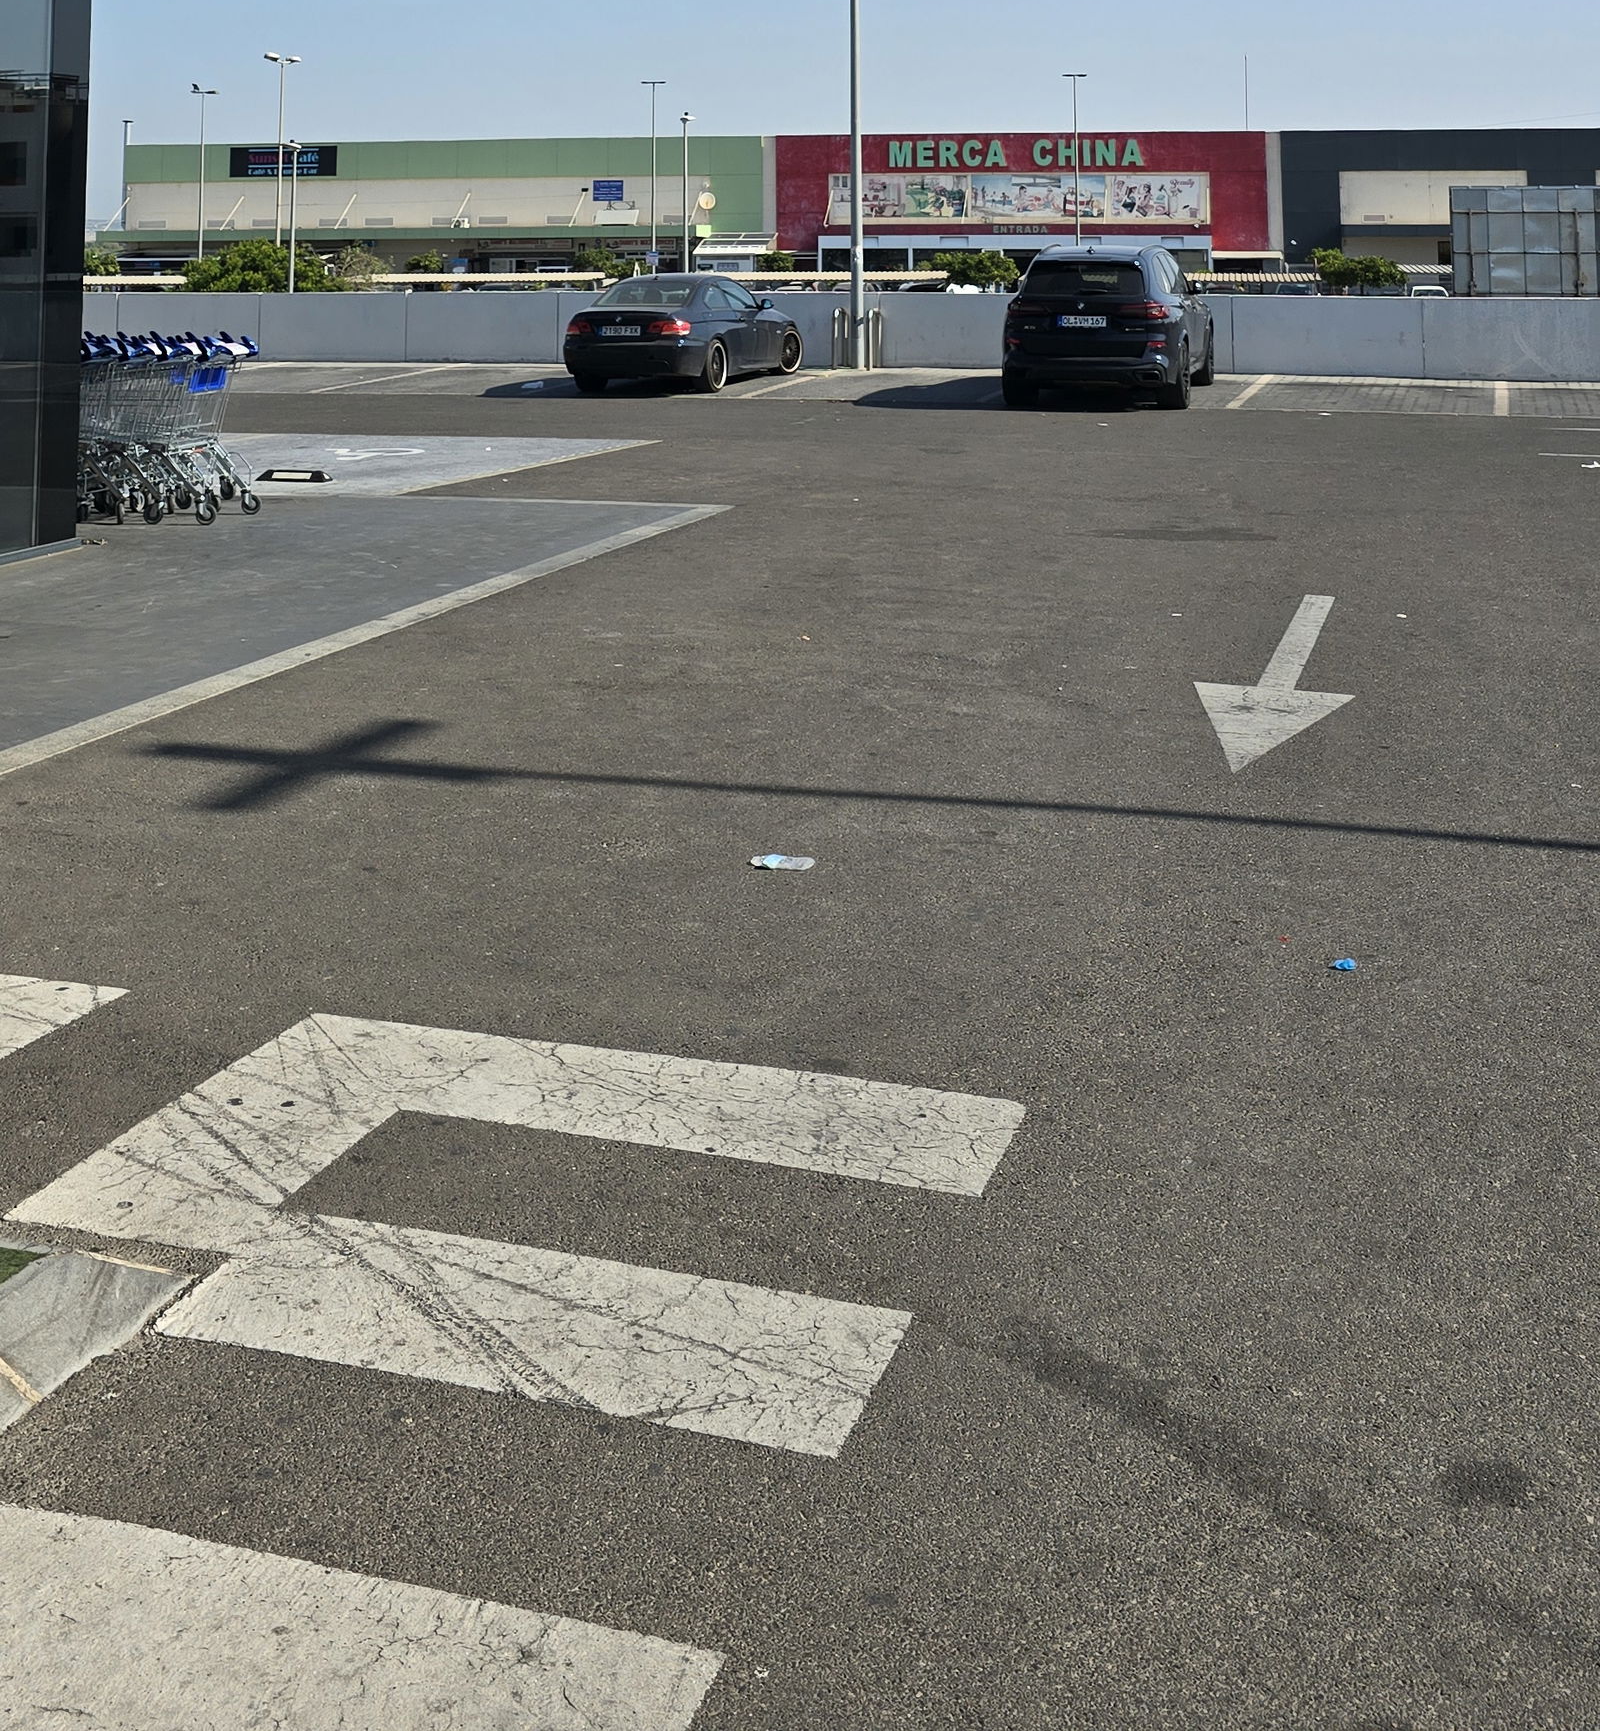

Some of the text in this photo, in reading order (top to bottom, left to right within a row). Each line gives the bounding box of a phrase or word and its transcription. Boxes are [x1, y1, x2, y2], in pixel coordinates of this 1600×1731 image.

[248, 152, 291, 164] Sunst
[888, 138, 1145, 168] MERCA CHINA
[992, 225, 1048, 234] ENTRADA
[1090, 316, 1105, 325] 167
